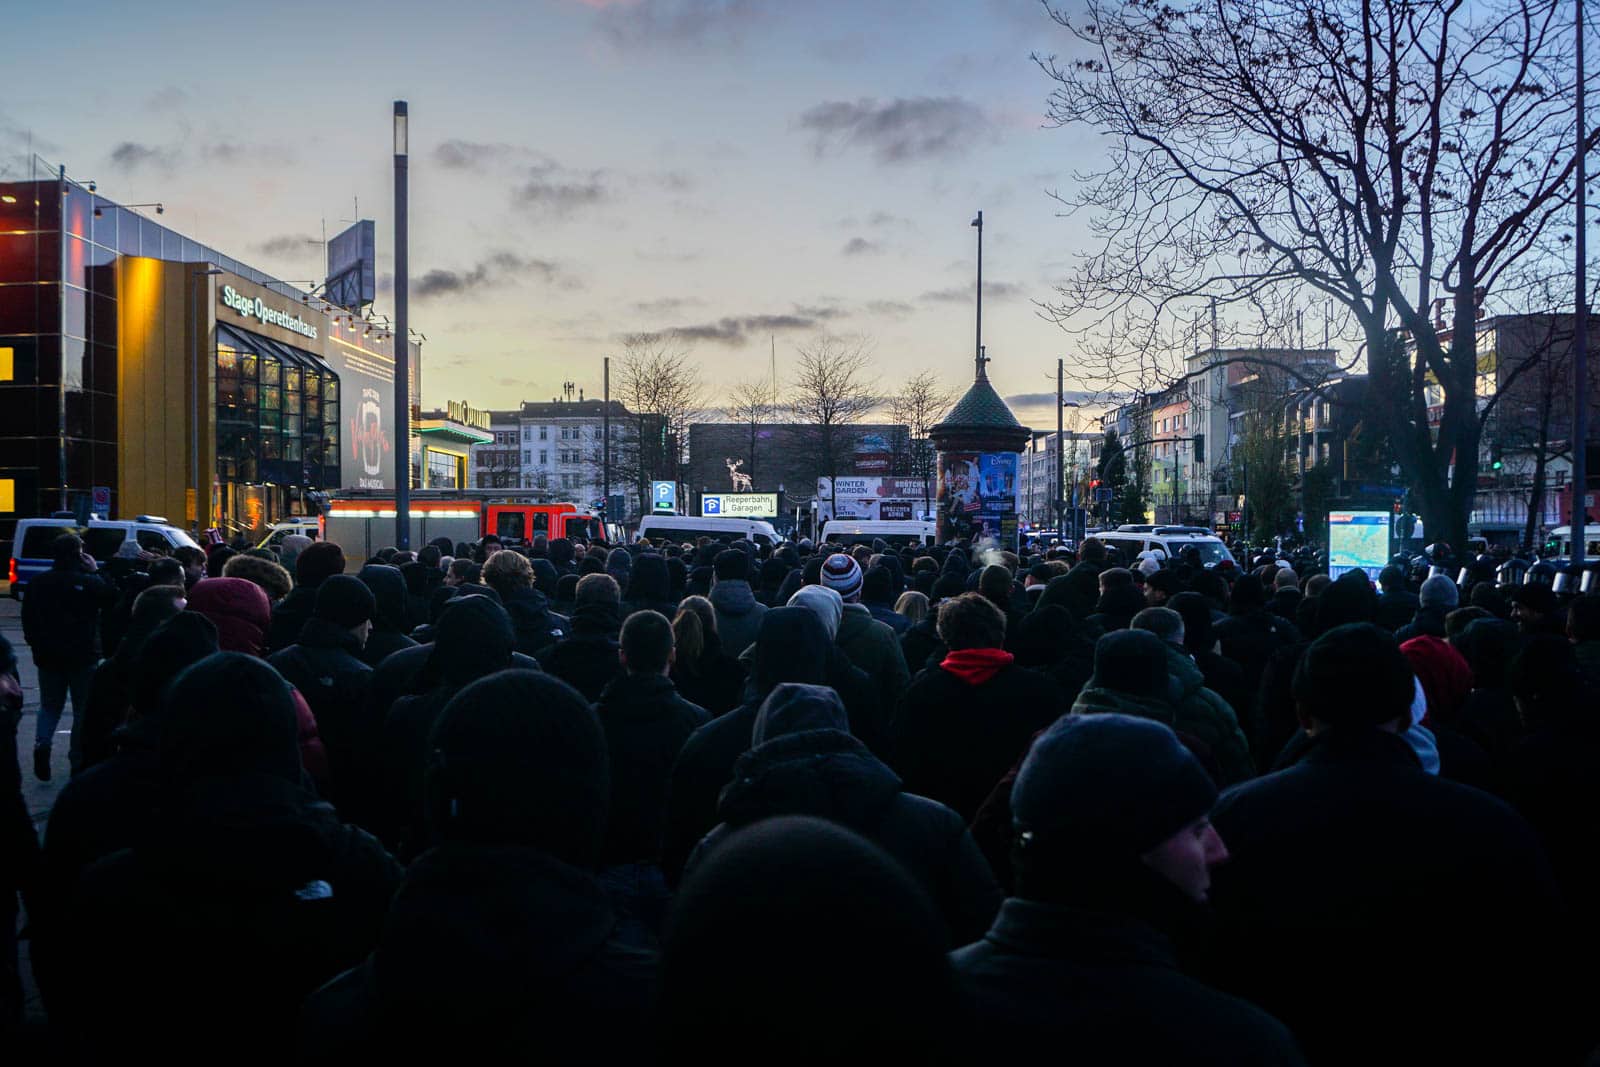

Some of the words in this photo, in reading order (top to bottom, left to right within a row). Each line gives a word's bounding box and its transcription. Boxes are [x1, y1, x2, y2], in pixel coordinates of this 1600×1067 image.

[224, 285, 255, 317] Stage
[255, 298, 318, 339] Operettenhaus
[660, 487, 669, 499] P
[726, 495, 770, 504] Reeperbahn
[709, 502, 716, 512] P
[731, 505, 763, 513] Garagen
